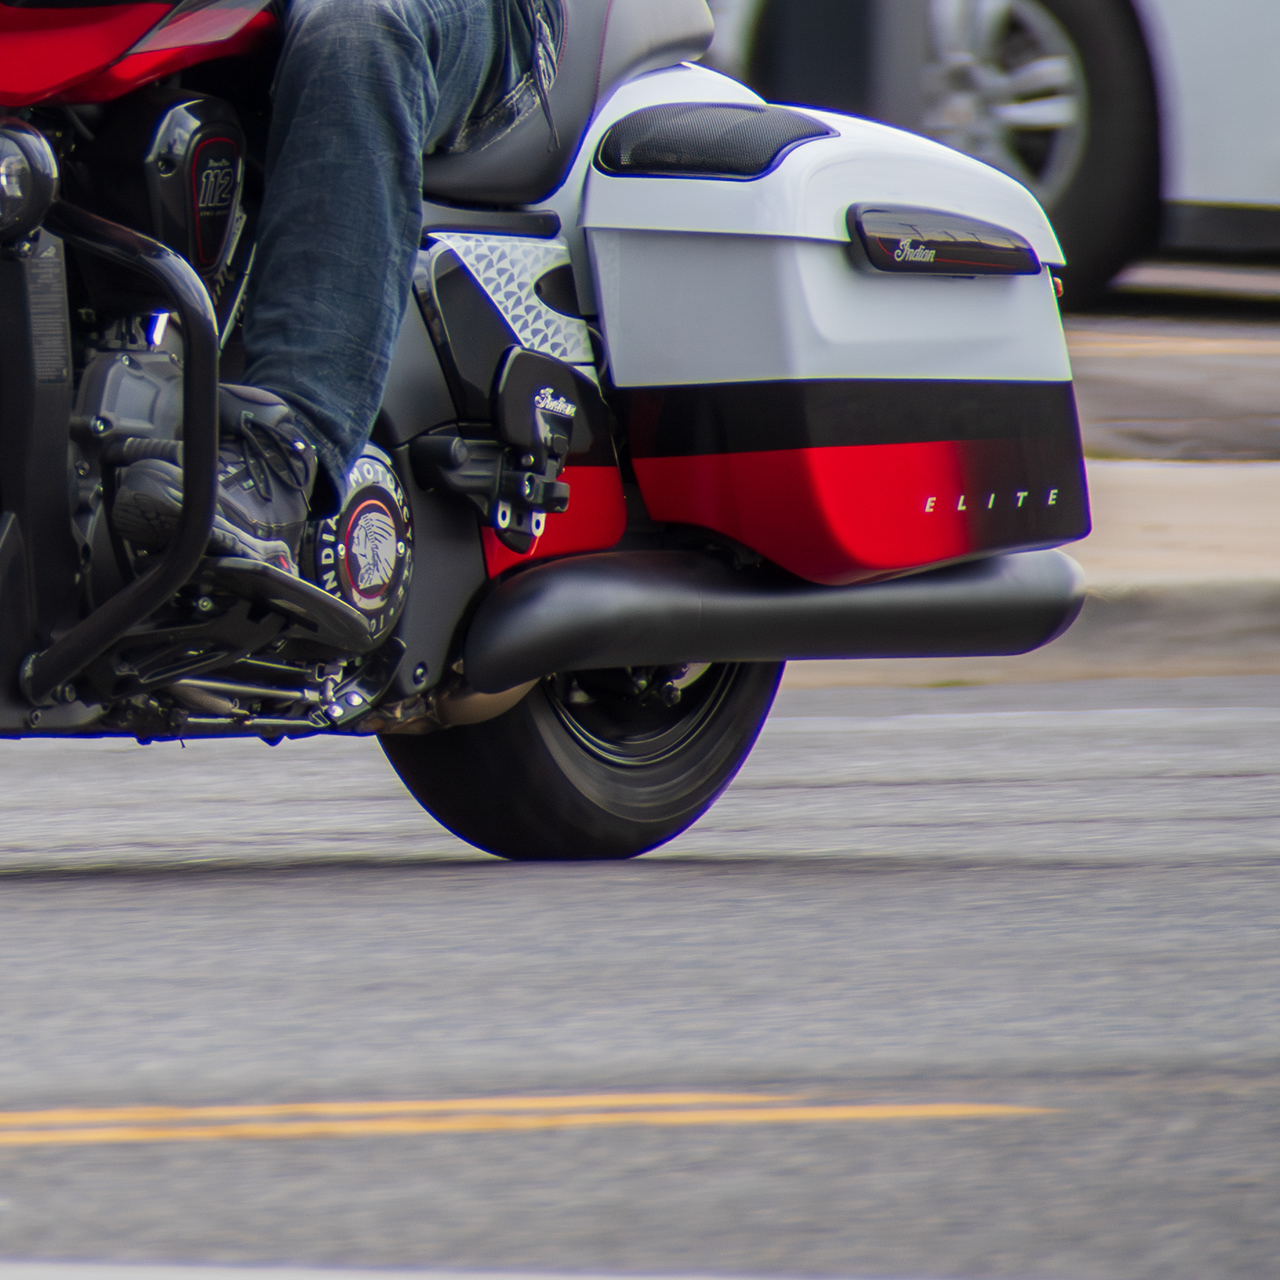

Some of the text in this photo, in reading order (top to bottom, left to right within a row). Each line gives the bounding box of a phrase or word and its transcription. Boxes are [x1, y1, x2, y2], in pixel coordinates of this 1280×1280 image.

[199, 169, 233, 207] 112
[894, 238, 936, 263] Indian
[534, 387, 577, 417] Indian
[924, 489, 1059, 513] ELITE
[321, 515, 342, 598] NDIA
